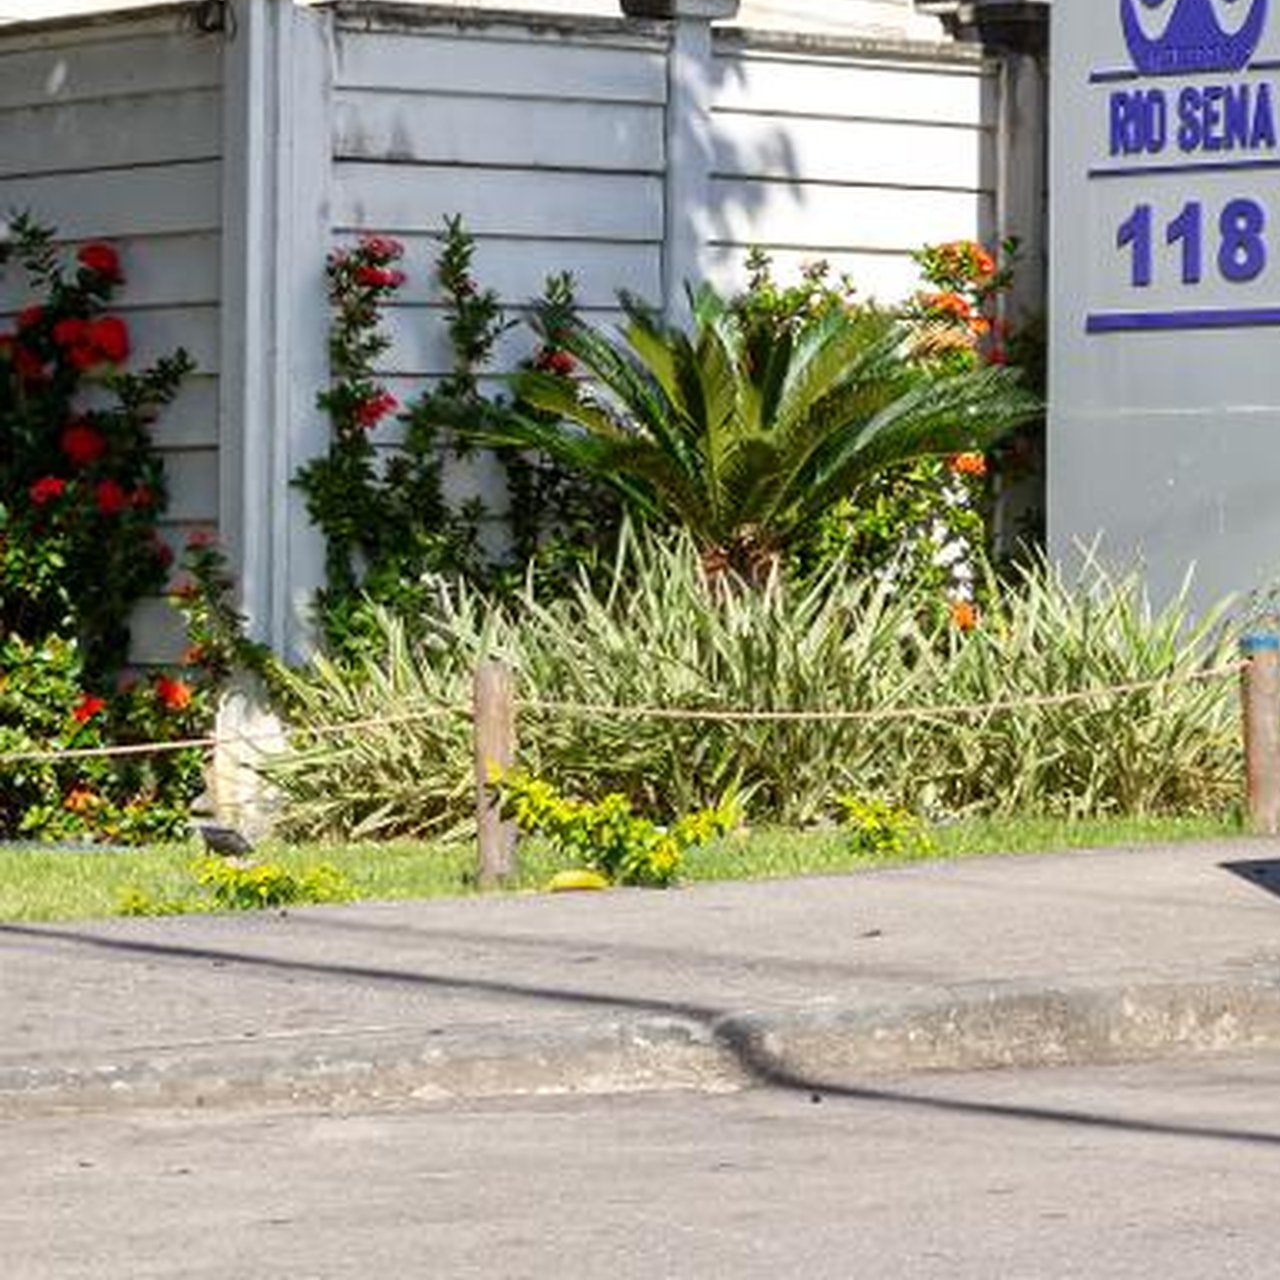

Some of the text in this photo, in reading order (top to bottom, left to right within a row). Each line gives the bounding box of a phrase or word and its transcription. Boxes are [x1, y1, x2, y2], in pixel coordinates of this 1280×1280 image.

[1109, 83, 1276, 156] RIO SENA
[1116, 198, 1267, 287] 118
